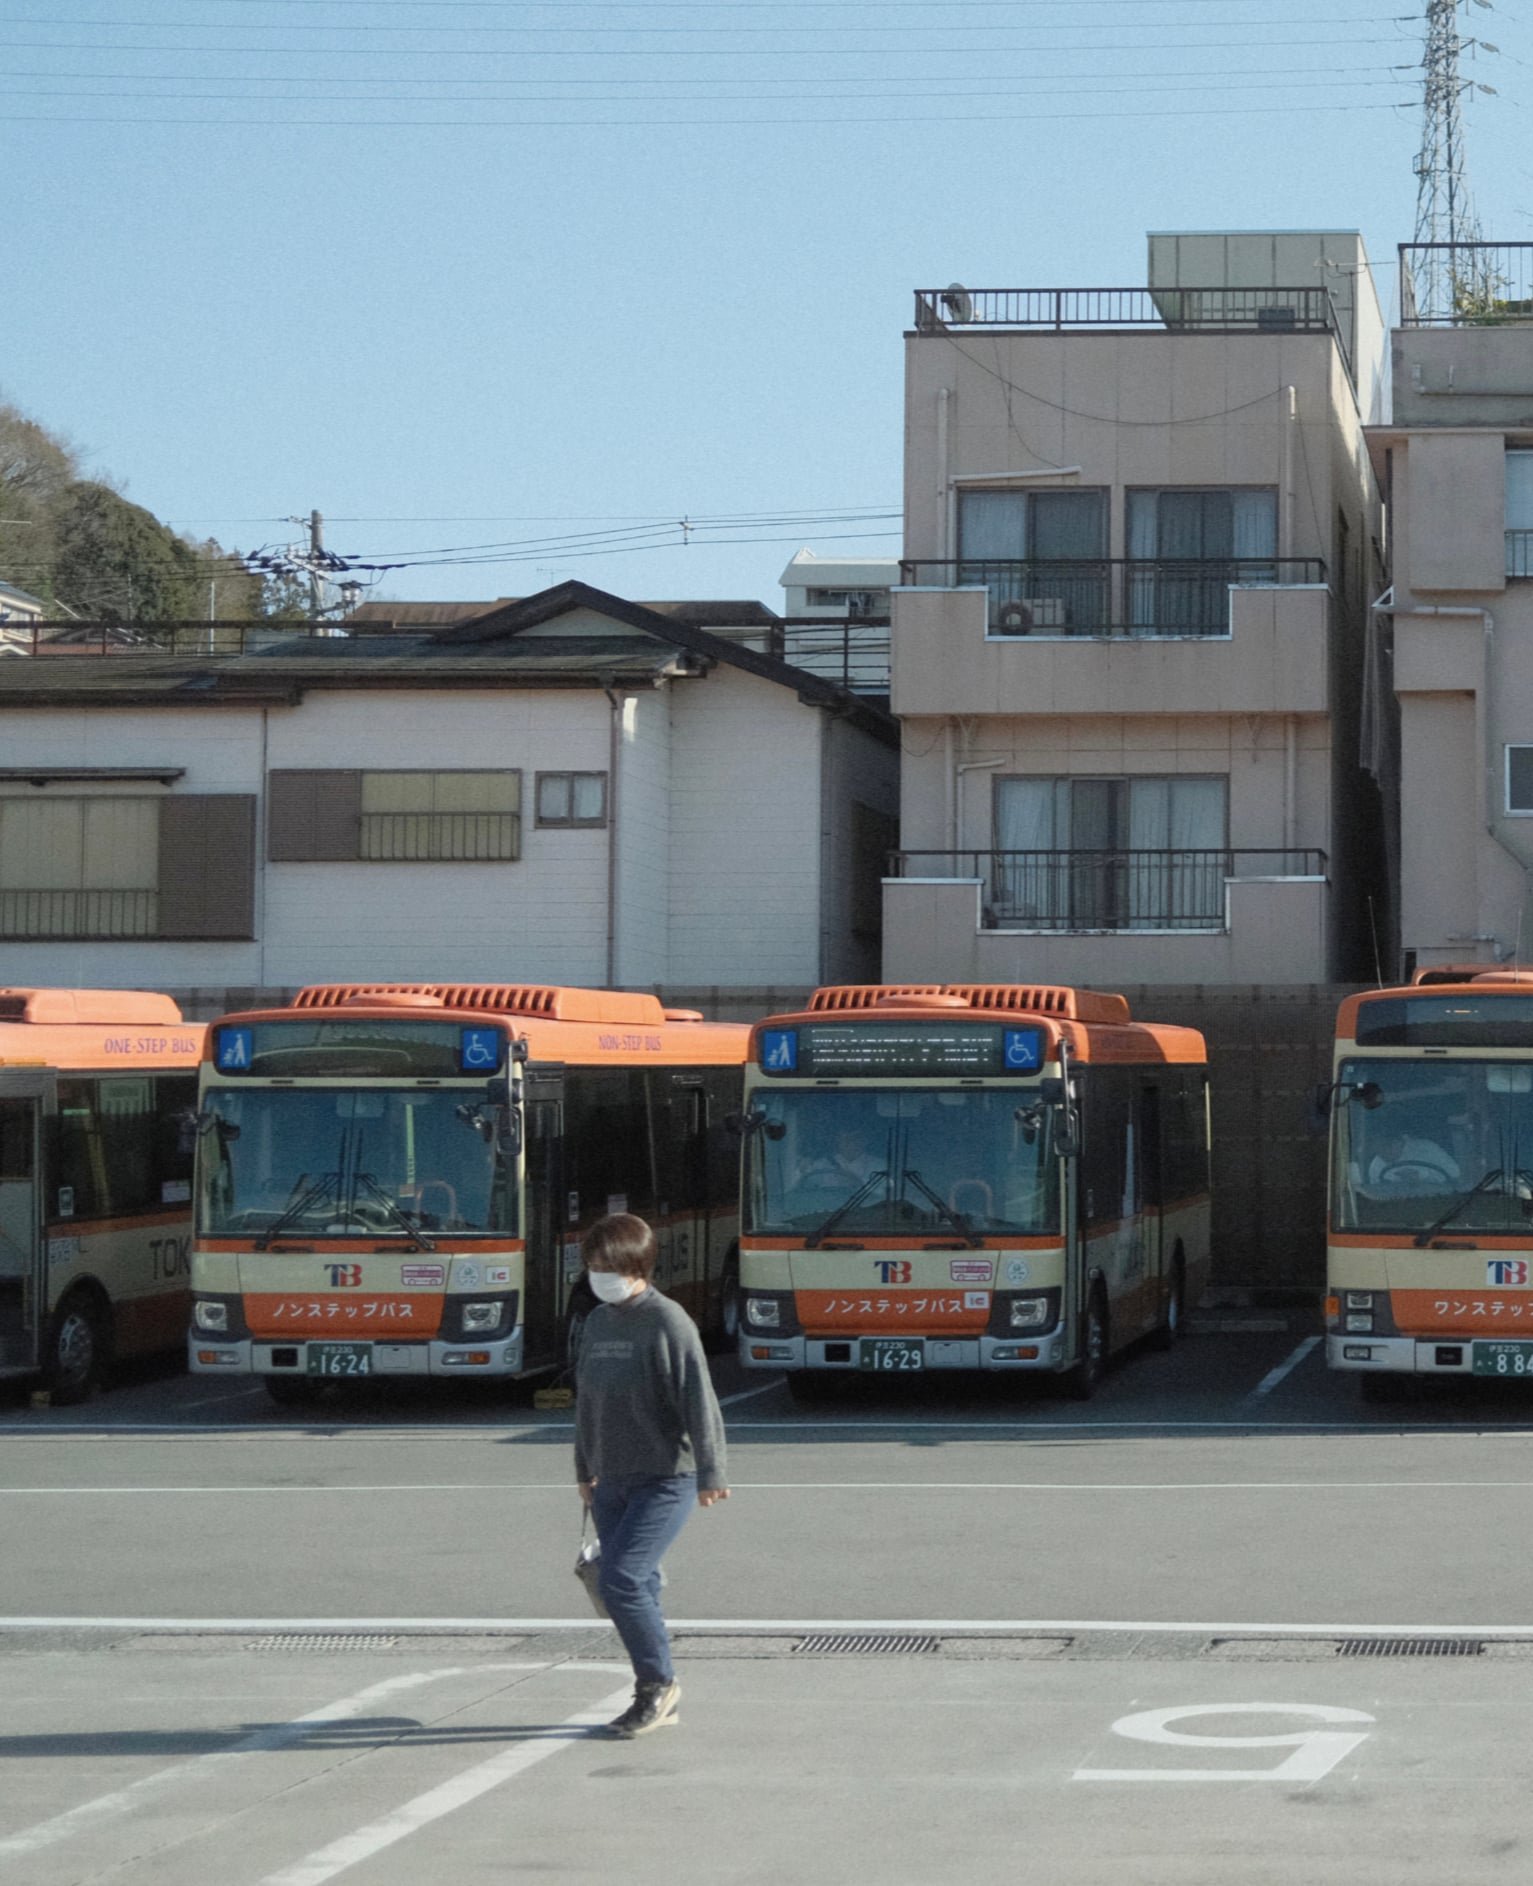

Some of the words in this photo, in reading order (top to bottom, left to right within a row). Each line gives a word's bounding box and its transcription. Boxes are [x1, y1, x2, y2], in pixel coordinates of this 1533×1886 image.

[104, 1038, 168, 1054] ONE-STEP
[172, 1038, 197, 1054] BUS
[149, 1236, 192, 1280] TOK
[323, 1263, 362, 1287] TB
[874, 1260, 912, 1284] TB
[1488, 1260, 1527, 1285] TB
[273, 1303, 413, 1318] ノンステップバス
[824, 1298, 962, 1314] ノンステップバス
